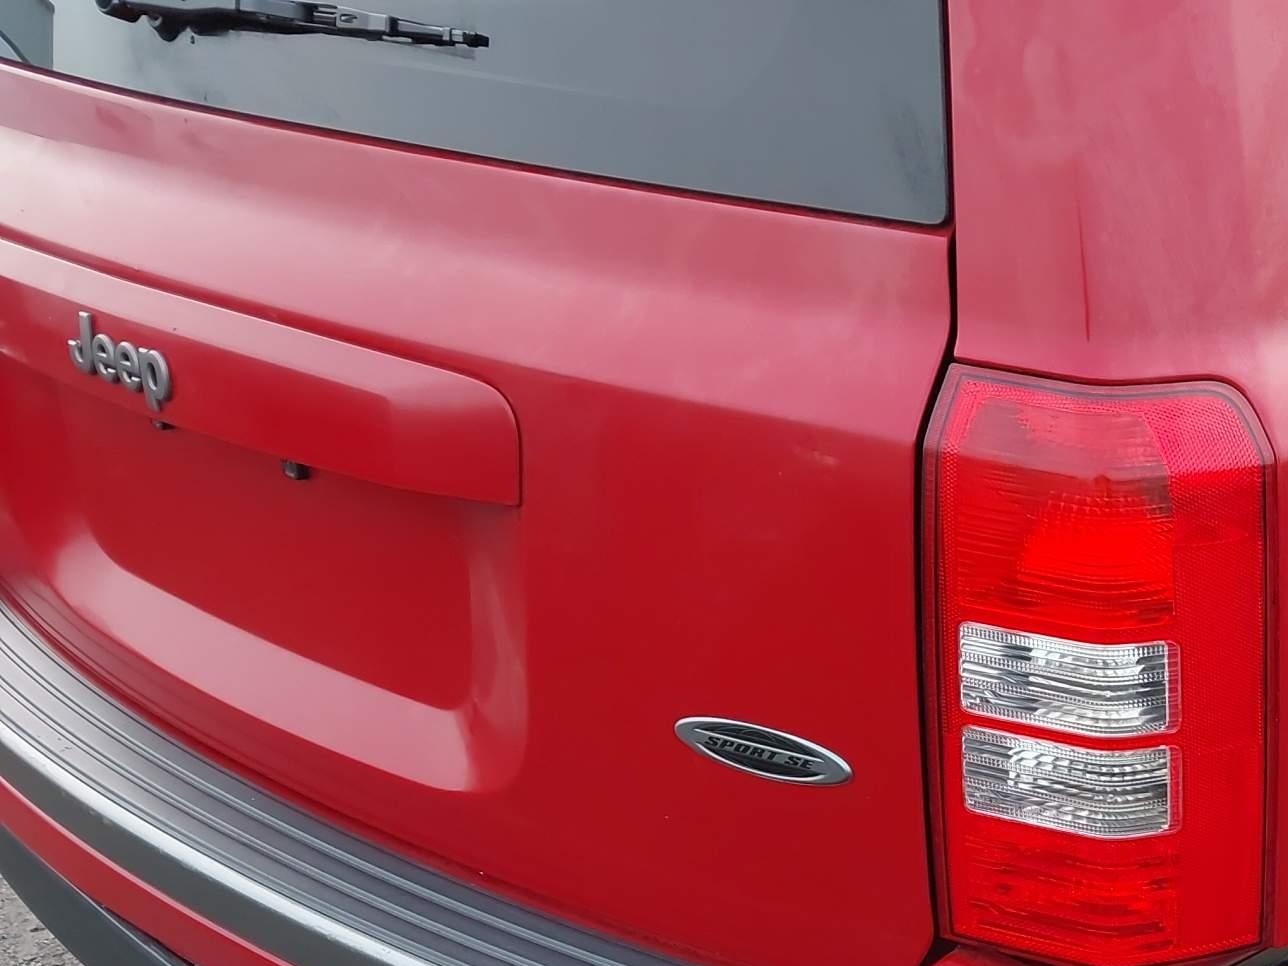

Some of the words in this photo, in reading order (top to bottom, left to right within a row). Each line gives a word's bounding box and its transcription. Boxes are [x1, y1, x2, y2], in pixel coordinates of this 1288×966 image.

[68, 311, 173, 411] Jeep
[704, 736, 777, 761] SPORT
[785, 757, 814, 770] SE
